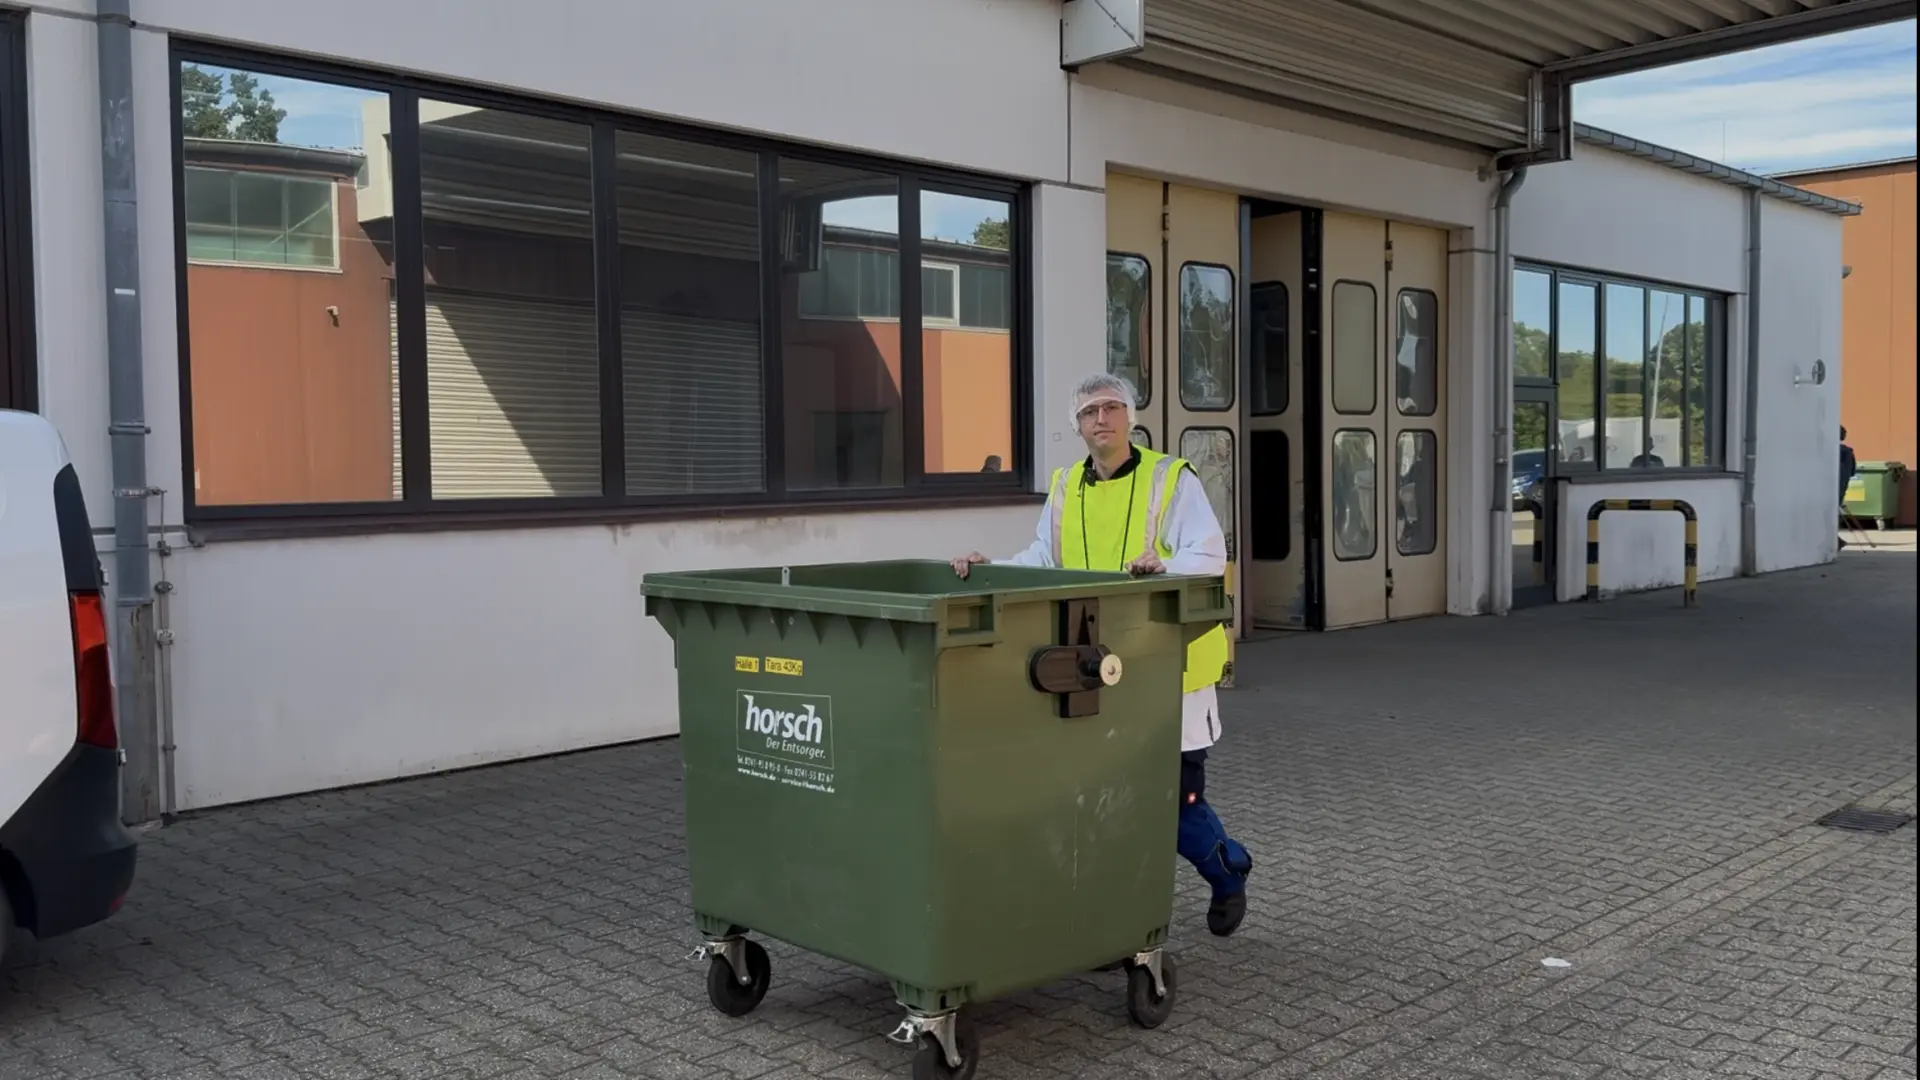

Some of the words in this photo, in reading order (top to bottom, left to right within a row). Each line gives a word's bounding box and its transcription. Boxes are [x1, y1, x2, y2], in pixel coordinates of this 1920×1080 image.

[743, 694, 823, 743] horsch
[766, 736, 780, 749] Der
[782, 739, 826, 759] Entsorger.
